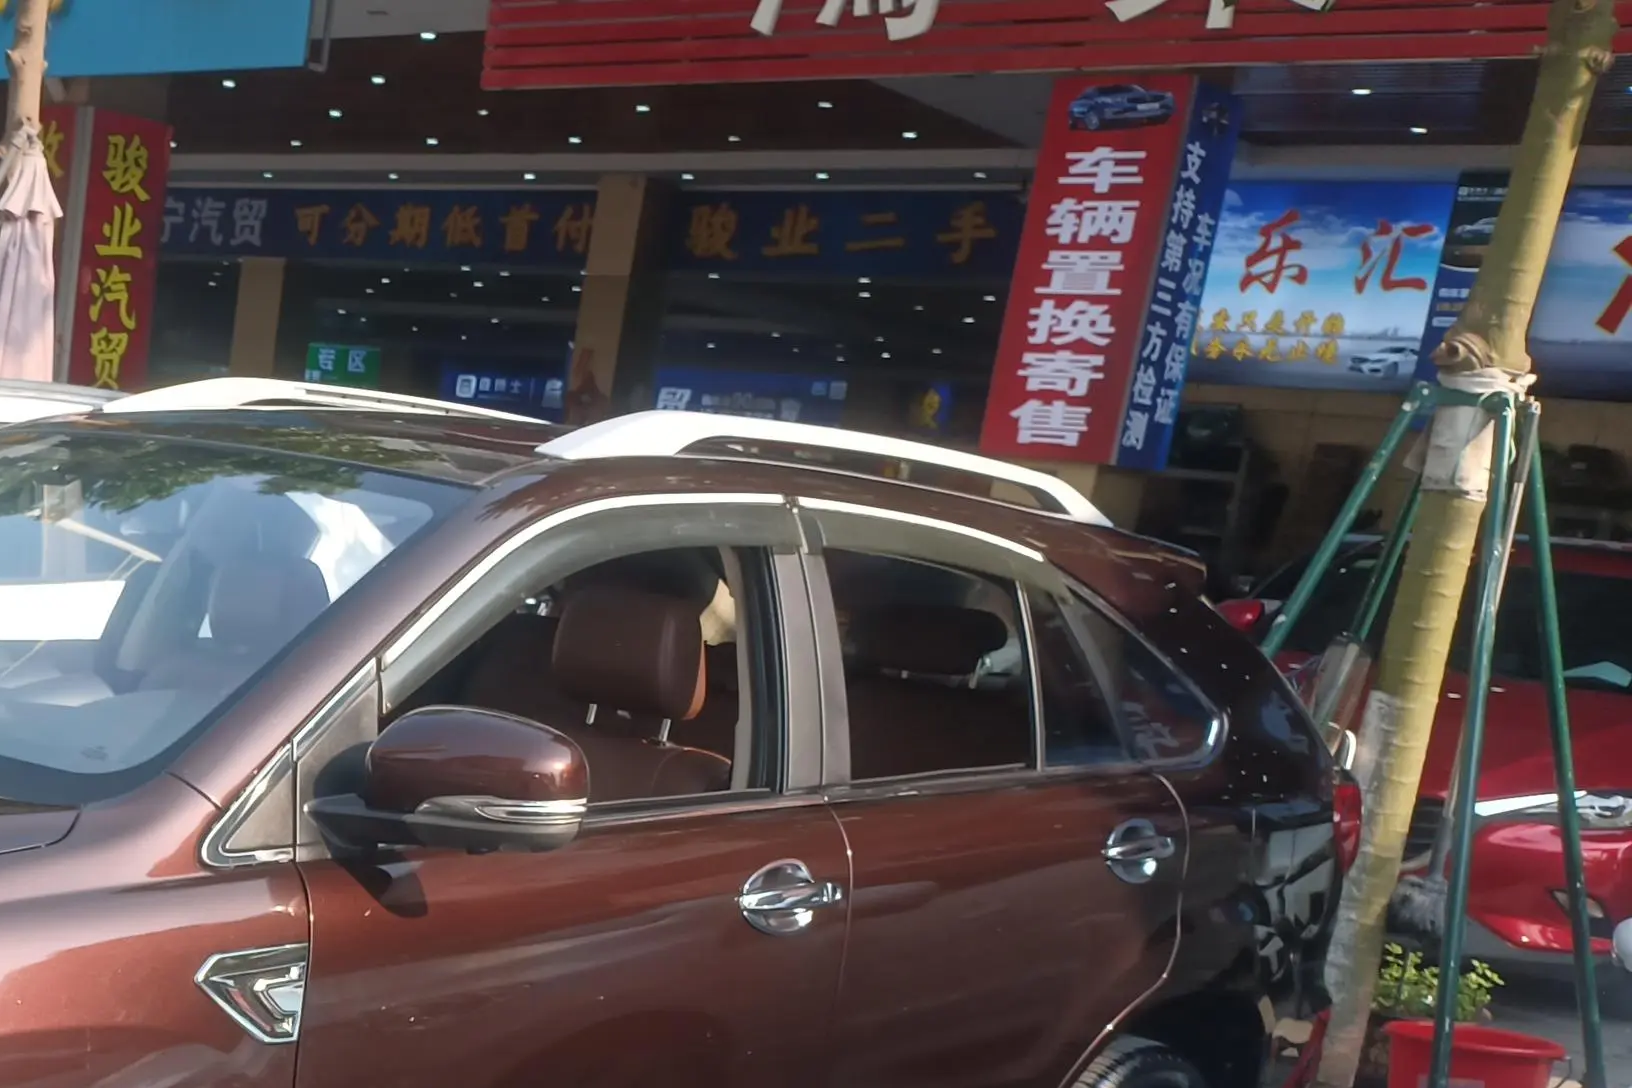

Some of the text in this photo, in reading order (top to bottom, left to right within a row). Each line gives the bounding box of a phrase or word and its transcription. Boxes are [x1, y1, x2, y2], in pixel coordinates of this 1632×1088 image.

[88, 134, 152, 390] 骏业汽贸
[293, 202, 595, 254] 可分期低首付
[1009, 146, 1147, 447] 车辆置换寄售
[1122, 141, 1206, 450] 支持第三方检测
[1239, 208, 1435, 295] 乐汇
